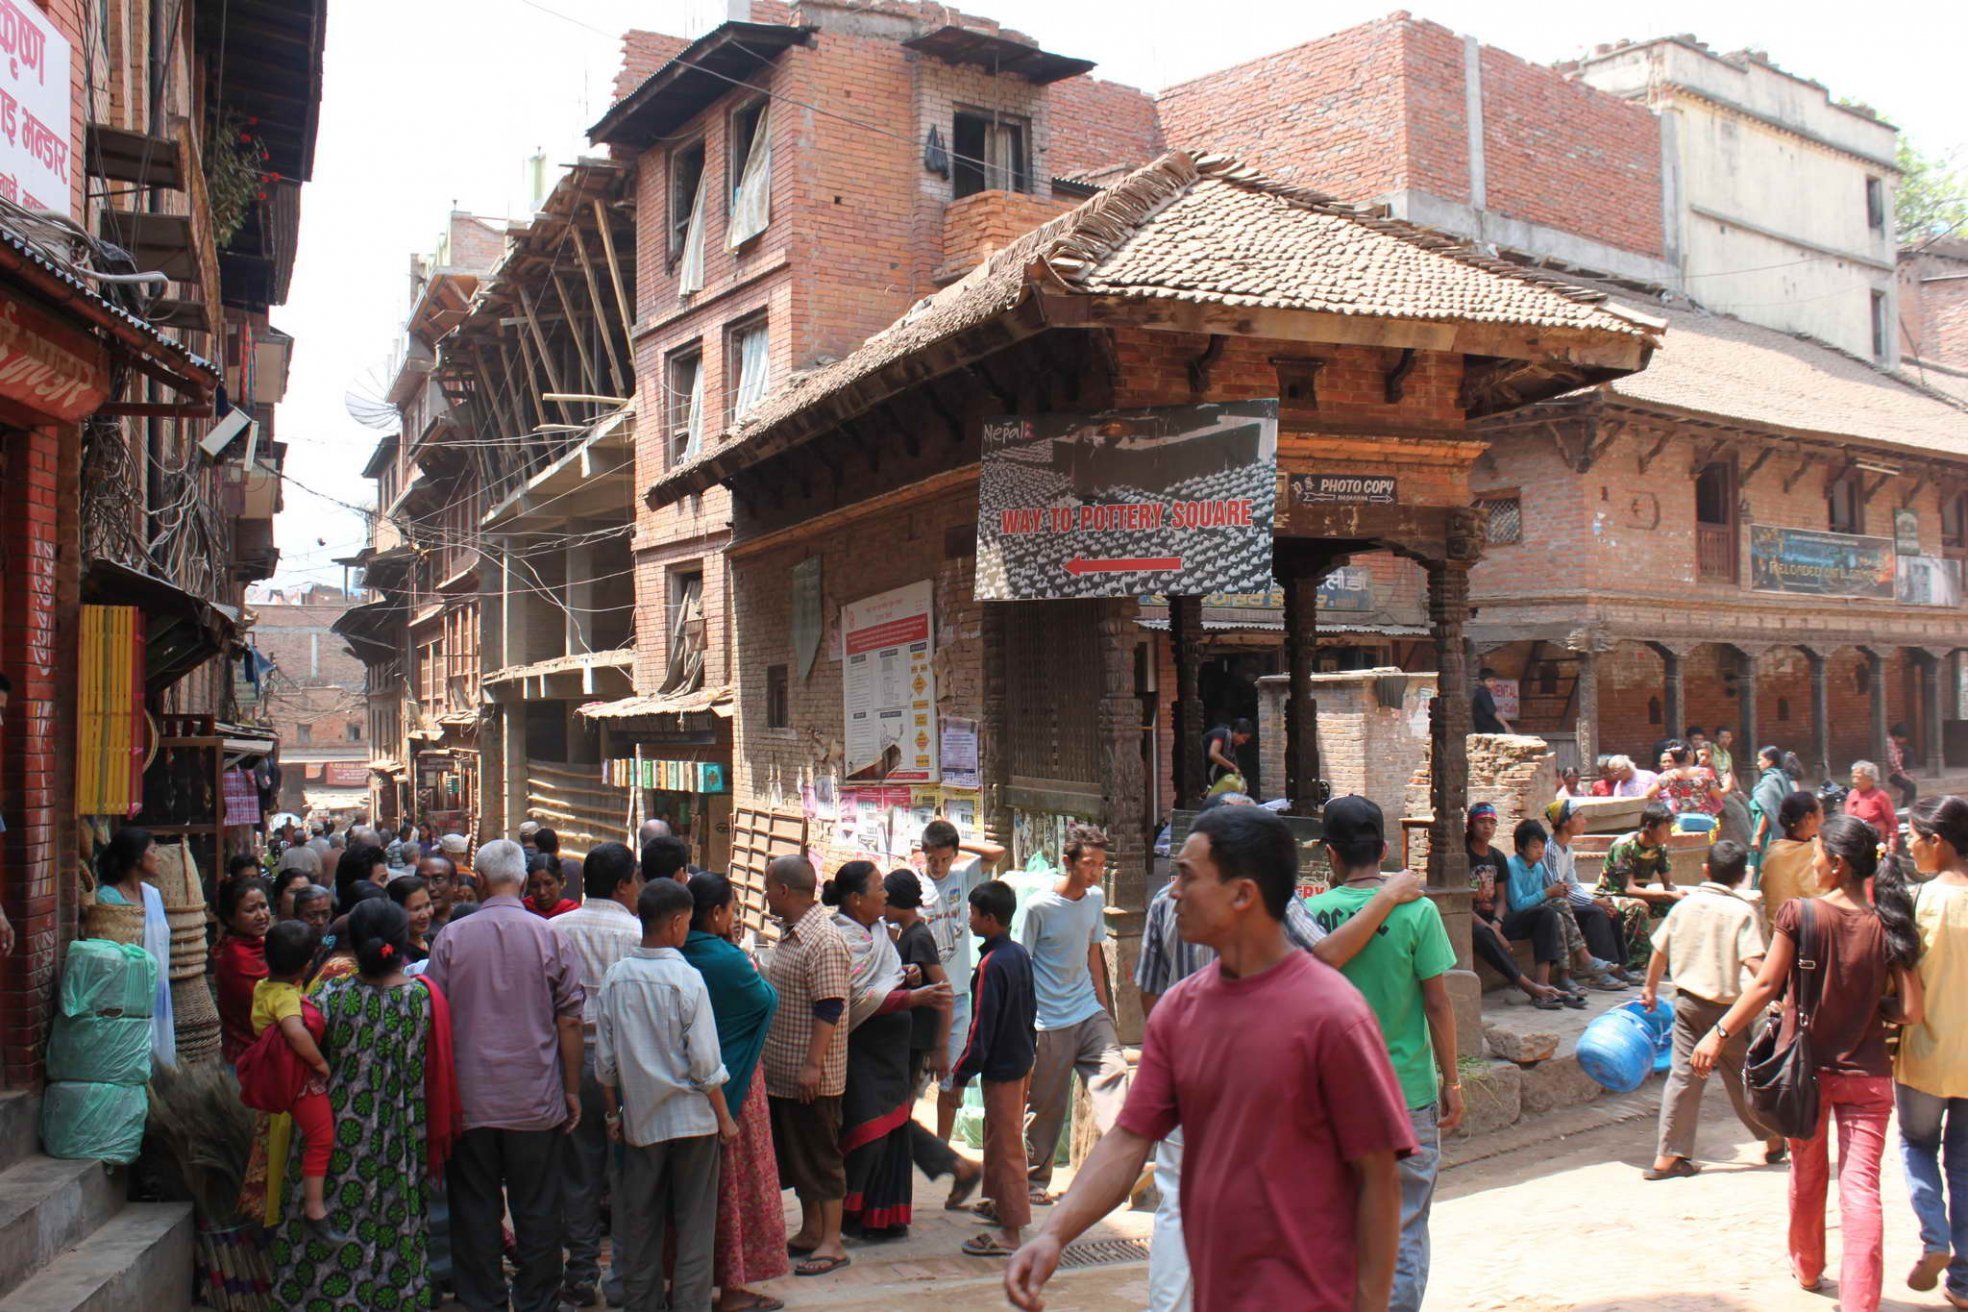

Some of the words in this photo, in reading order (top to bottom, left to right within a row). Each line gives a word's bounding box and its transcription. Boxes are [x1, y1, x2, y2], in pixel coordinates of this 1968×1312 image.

[22, 106, 68, 185] भन्डार
[983, 420, 1024, 444] Nepal
[1320, 479, 1362, 493] PHOTO
[1363, 480, 1395, 495] COPY
[1002, 508, 1043, 535] WAY
[1050, 507, 1073, 533] TO
[1080, 502, 1165, 531] POTTERY
[1171, 499, 1253, 530] SQUARE
